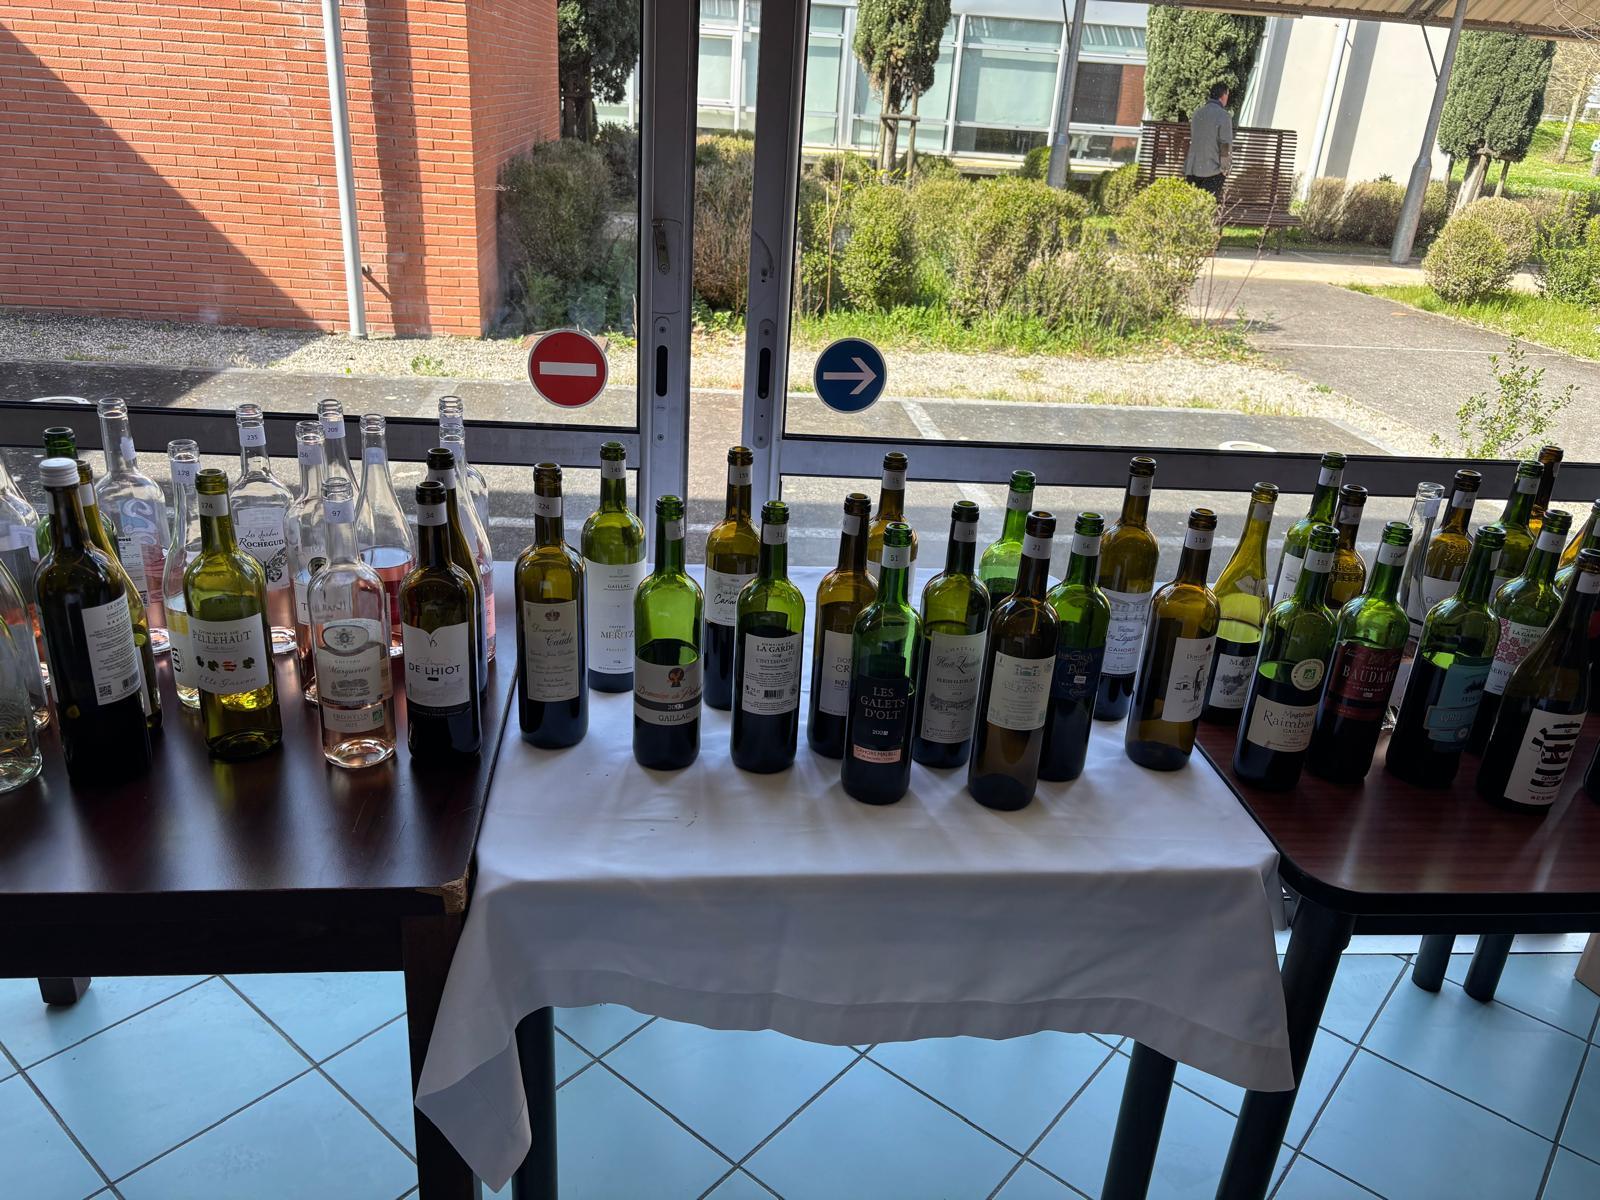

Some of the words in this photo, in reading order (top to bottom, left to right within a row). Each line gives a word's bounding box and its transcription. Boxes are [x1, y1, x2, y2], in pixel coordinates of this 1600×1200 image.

[331, 510, 341, 518] 97
[408, 662, 420, 673] DE
[425, 664, 461, 675] LHIOT
[872, 687, 895, 698] LES
[860, 695, 906, 709] GALETS
[658, 713, 690, 722] GAILLAC
[864, 708, 901, 720] D'OLT
